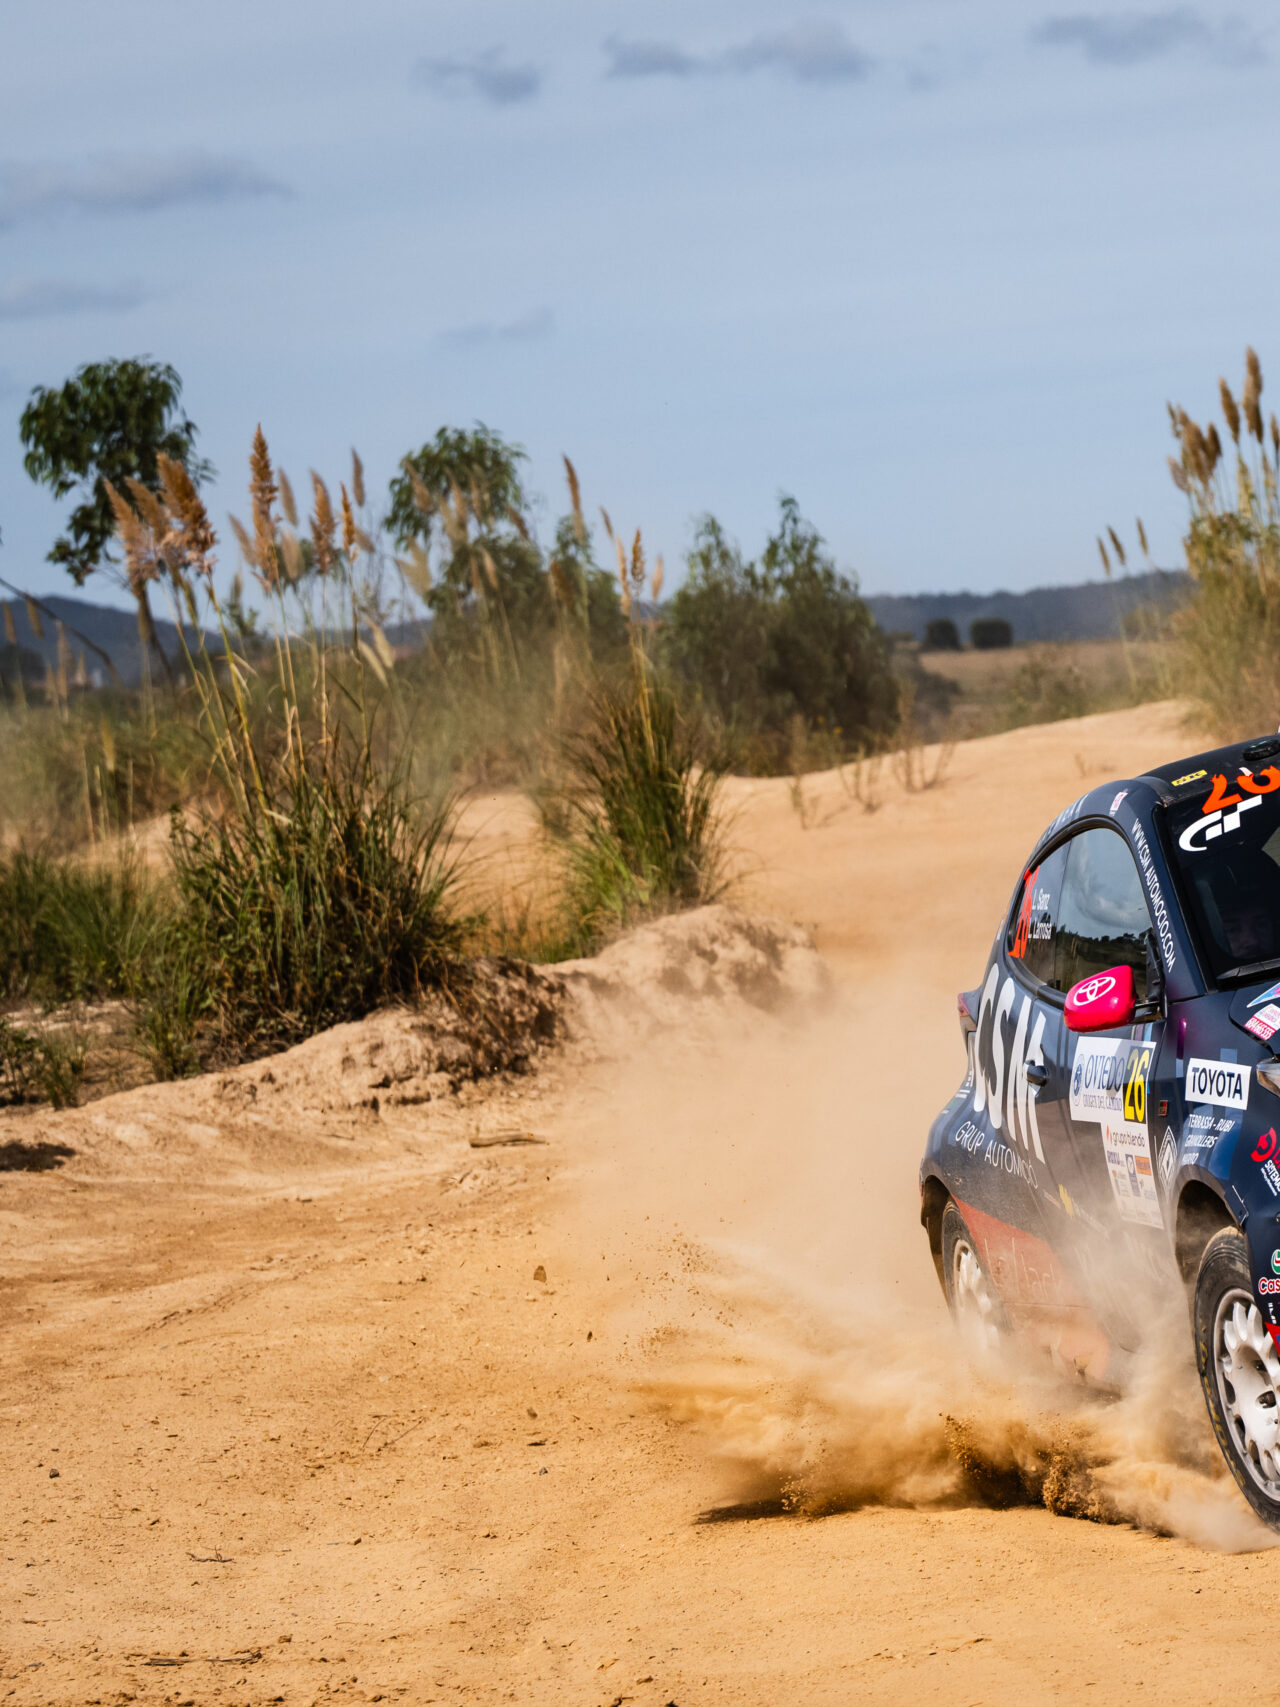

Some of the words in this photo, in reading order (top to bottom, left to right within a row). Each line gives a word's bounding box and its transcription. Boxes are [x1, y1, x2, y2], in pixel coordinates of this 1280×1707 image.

[973, 963, 1046, 1165] CSM
[1085, 1054, 1126, 1093] OVIEDO
[1124, 1049, 1150, 1123] 26
[1191, 1066, 1243, 1101] TOYOTA
[955, 1120, 985, 1155] GRUP
